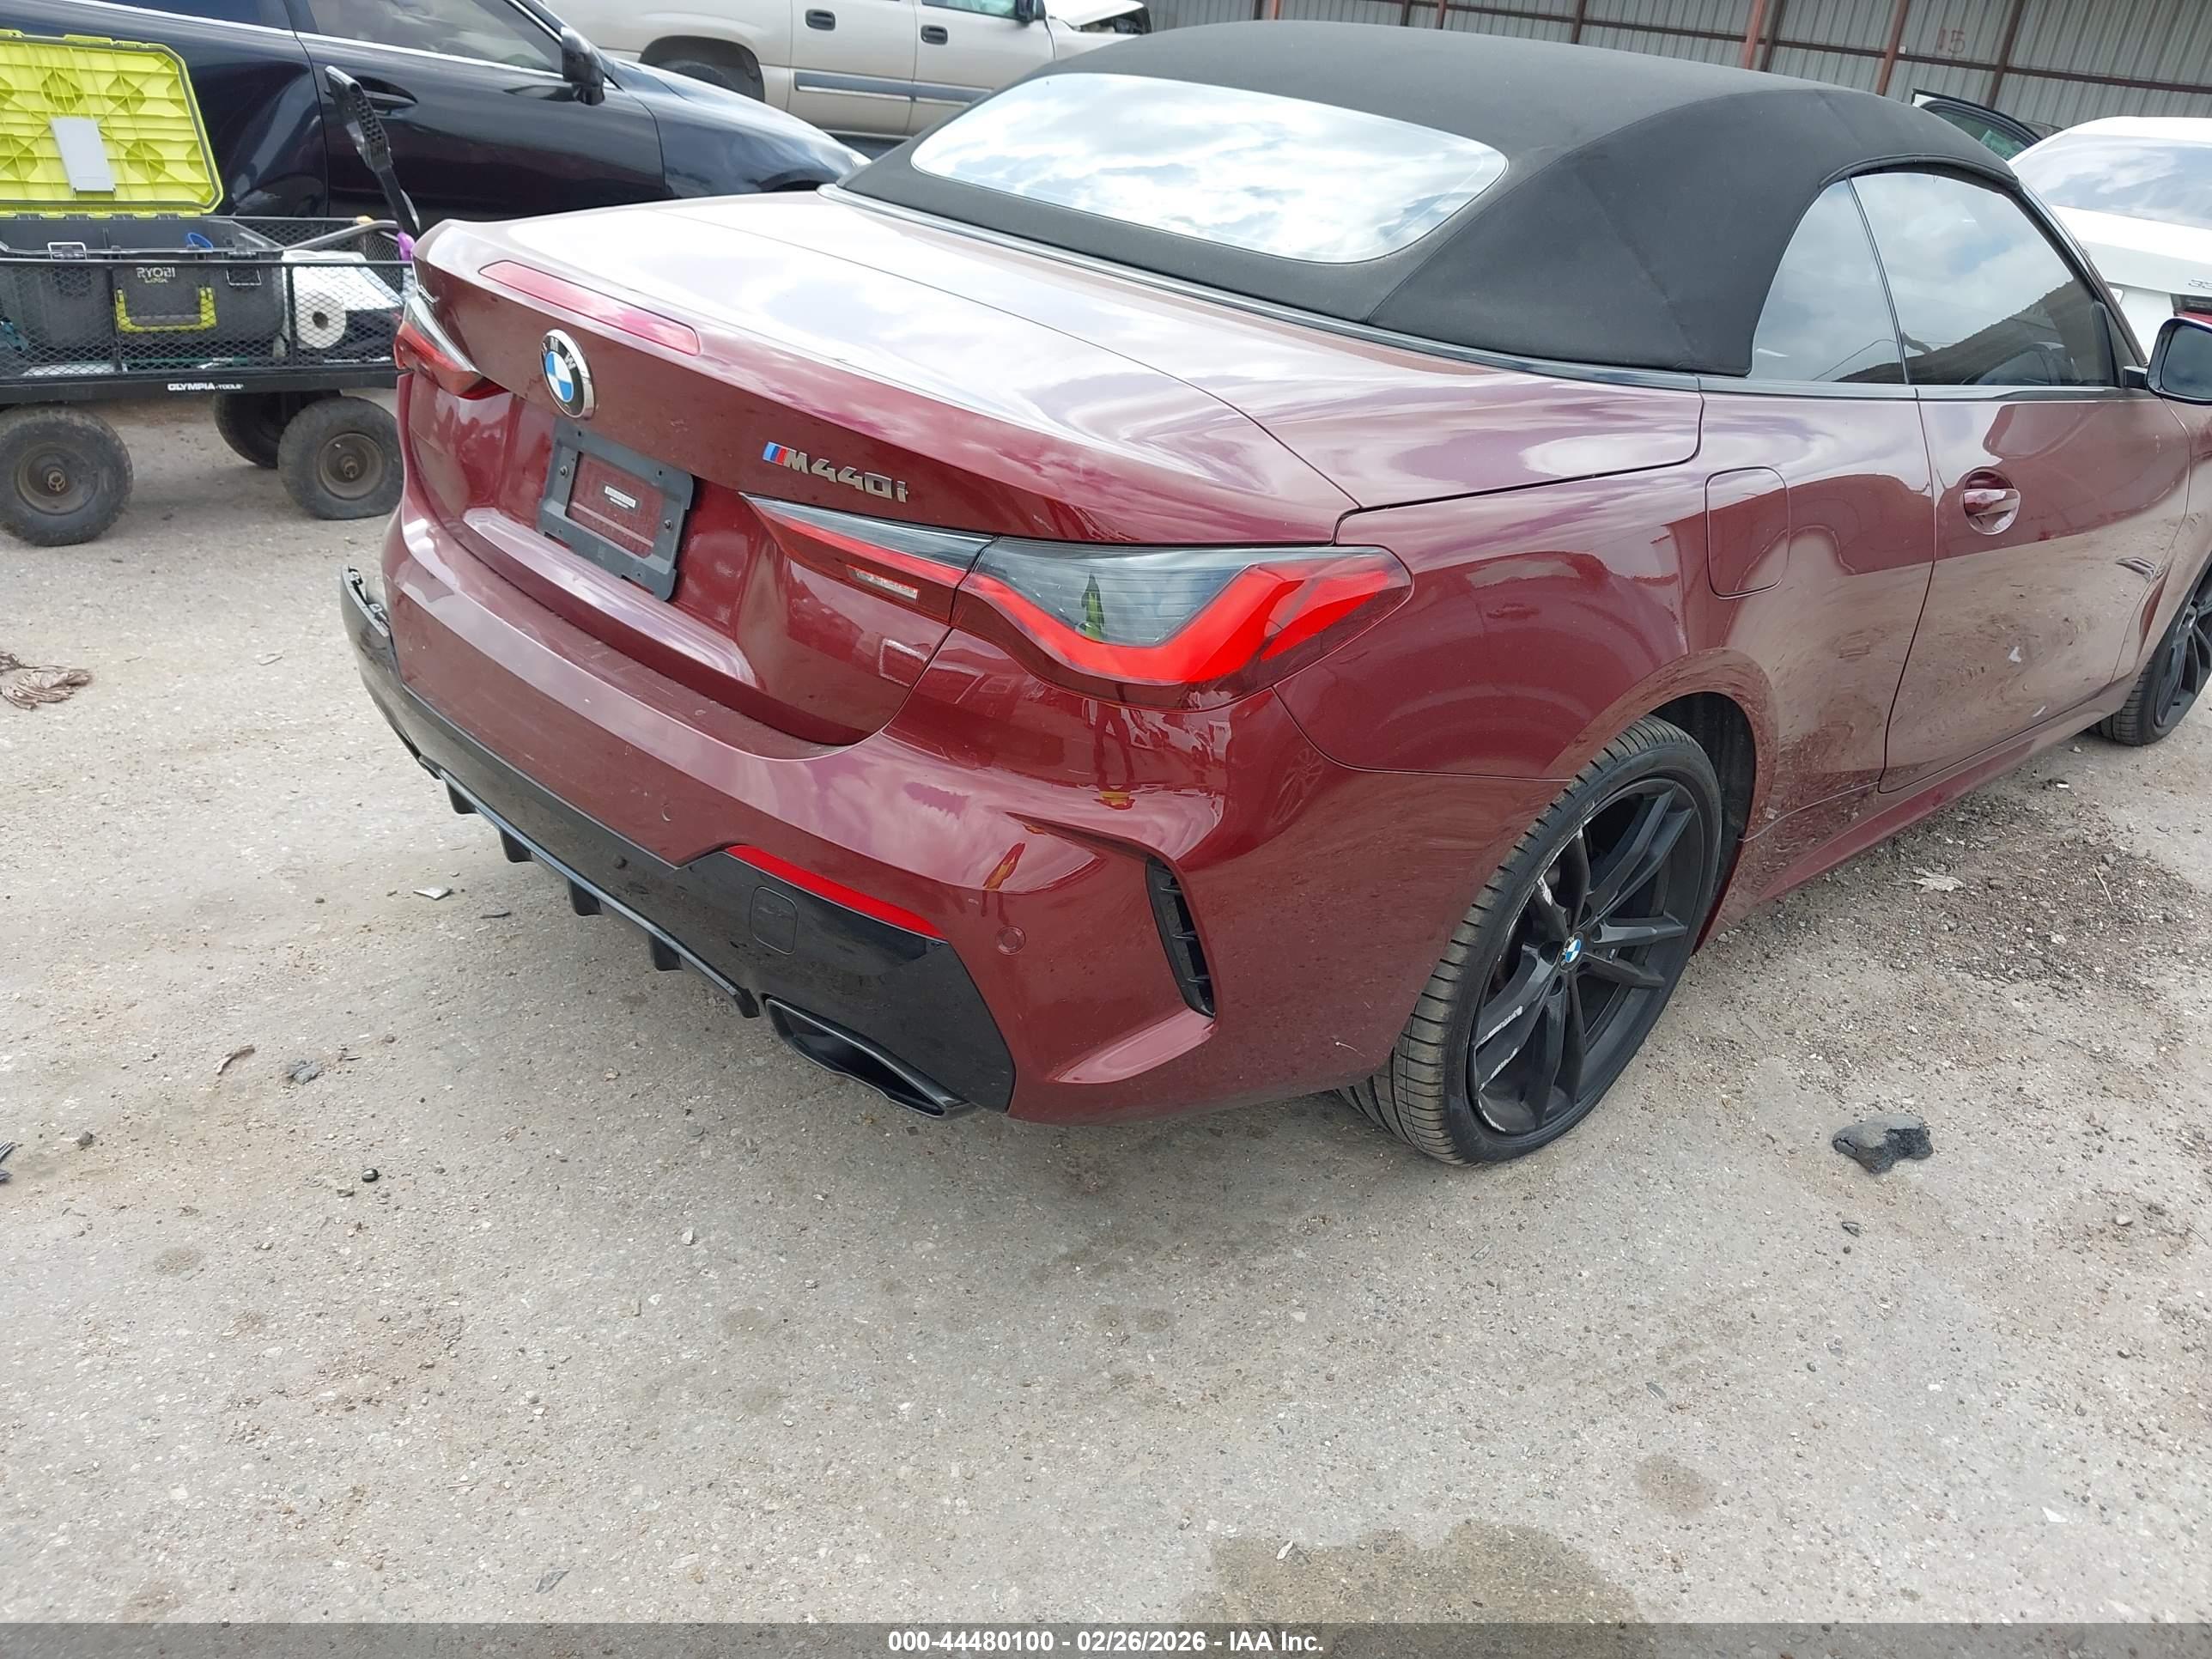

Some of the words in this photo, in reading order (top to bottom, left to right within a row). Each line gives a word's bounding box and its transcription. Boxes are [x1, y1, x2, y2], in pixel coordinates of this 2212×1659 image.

[136, 266, 176, 278] RYOBI
[167, 382, 216, 392] OLYMPIA
[782, 447, 908, 503] M440i
